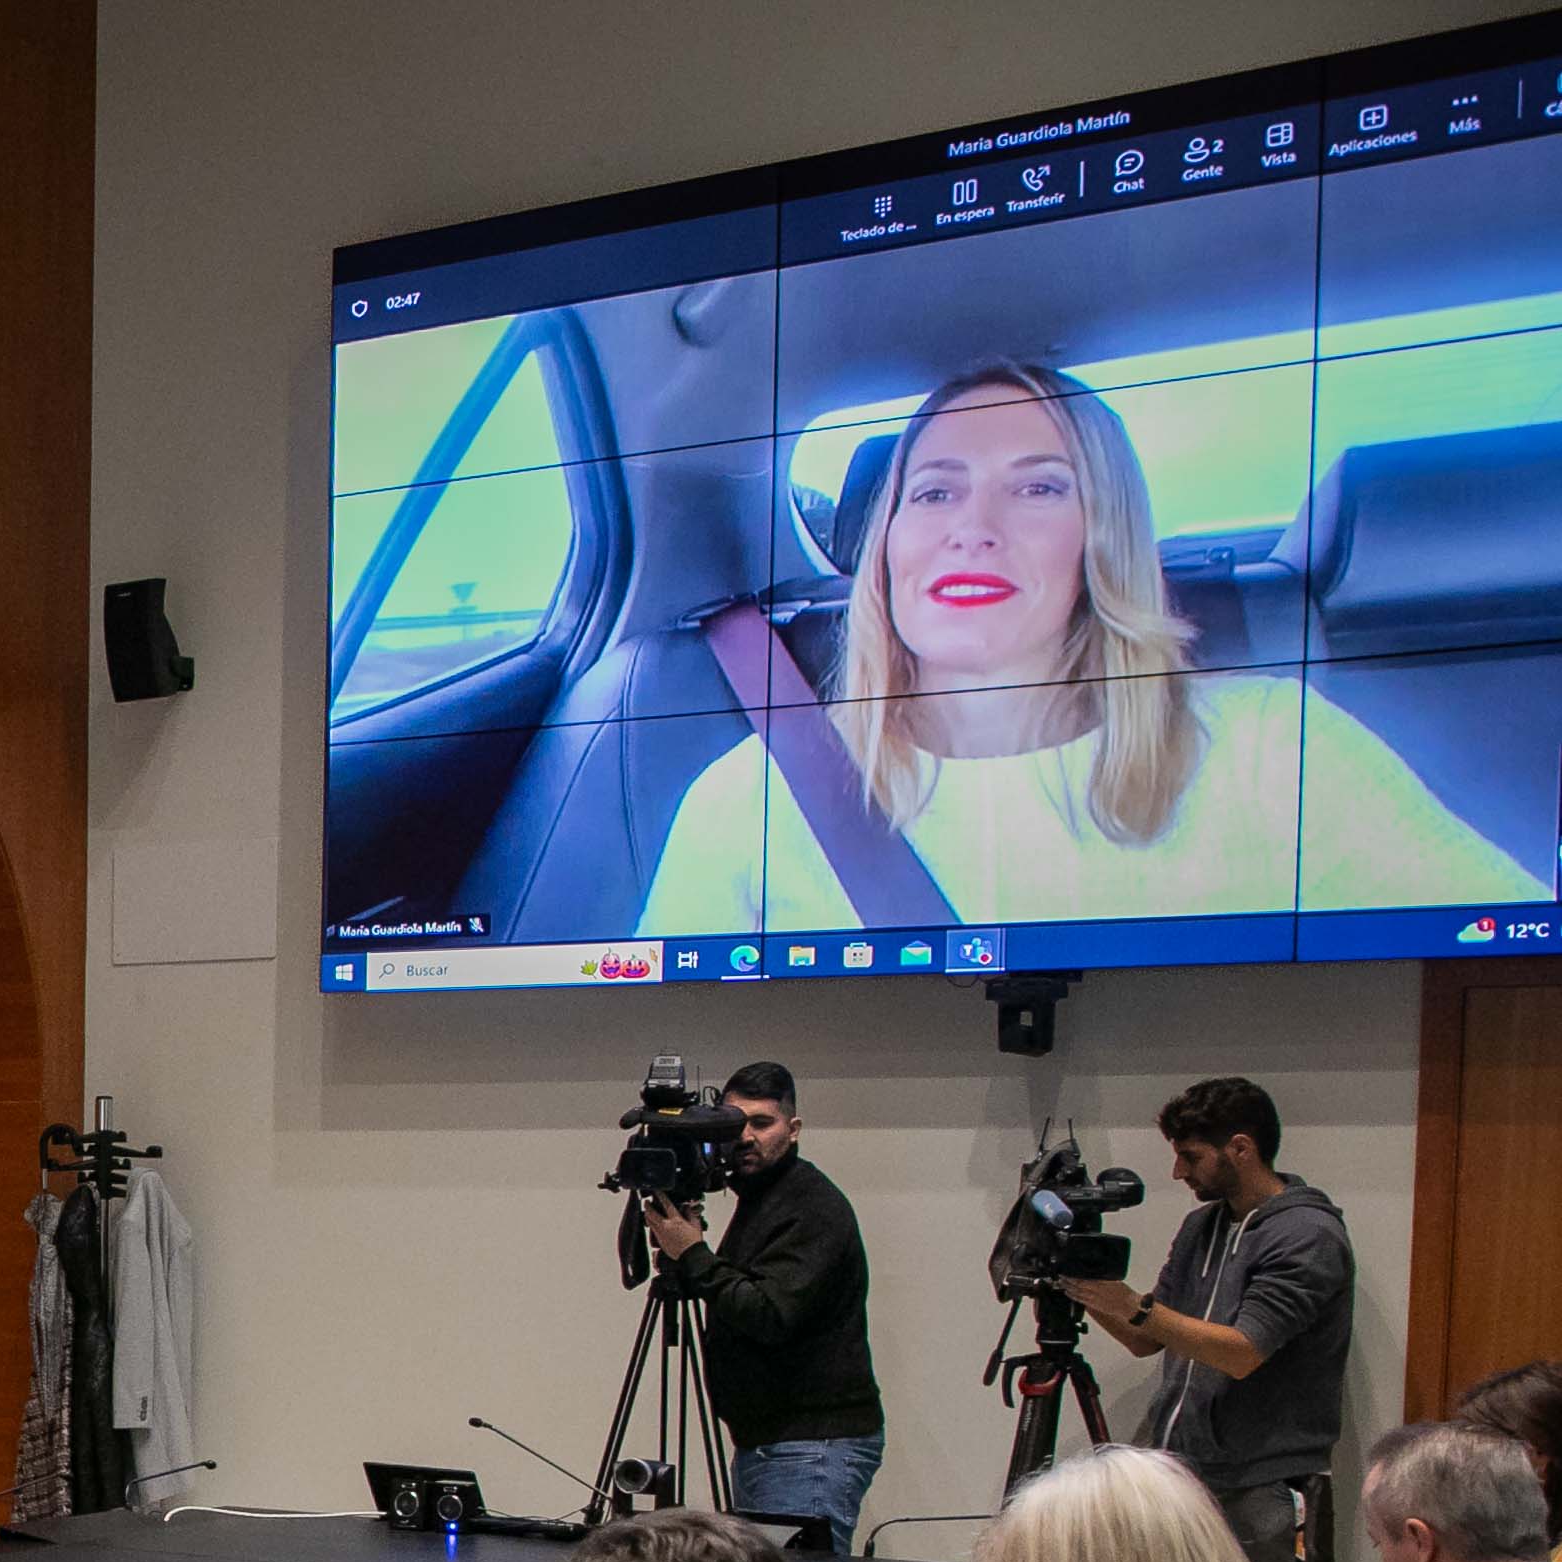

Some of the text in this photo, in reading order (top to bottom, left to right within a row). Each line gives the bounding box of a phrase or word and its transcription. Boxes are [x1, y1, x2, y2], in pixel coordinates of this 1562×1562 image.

[996, 122, 1073, 147] Guardiola
[1076, 110, 1130, 133] Martín
[1448, 116, 1482, 135] Más
[1328, 130, 1417, 156] Aplicaciones
[1261, 152, 1297, 168] Vista
[1182, 164, 1224, 181] Gente
[1113, 177, 1145, 193] Chat
[1006, 193, 1065, 213] Transferir
[936, 205, 995, 224] En espera
[841, 224, 885, 241] Teclado
[888, 220, 904, 233] de
[386, 292, 421, 310] 02:47
[371, 923, 423, 936] Guardiola
[425, 920, 462, 933] Martín
[406, 964, 449, 977] Buscar
